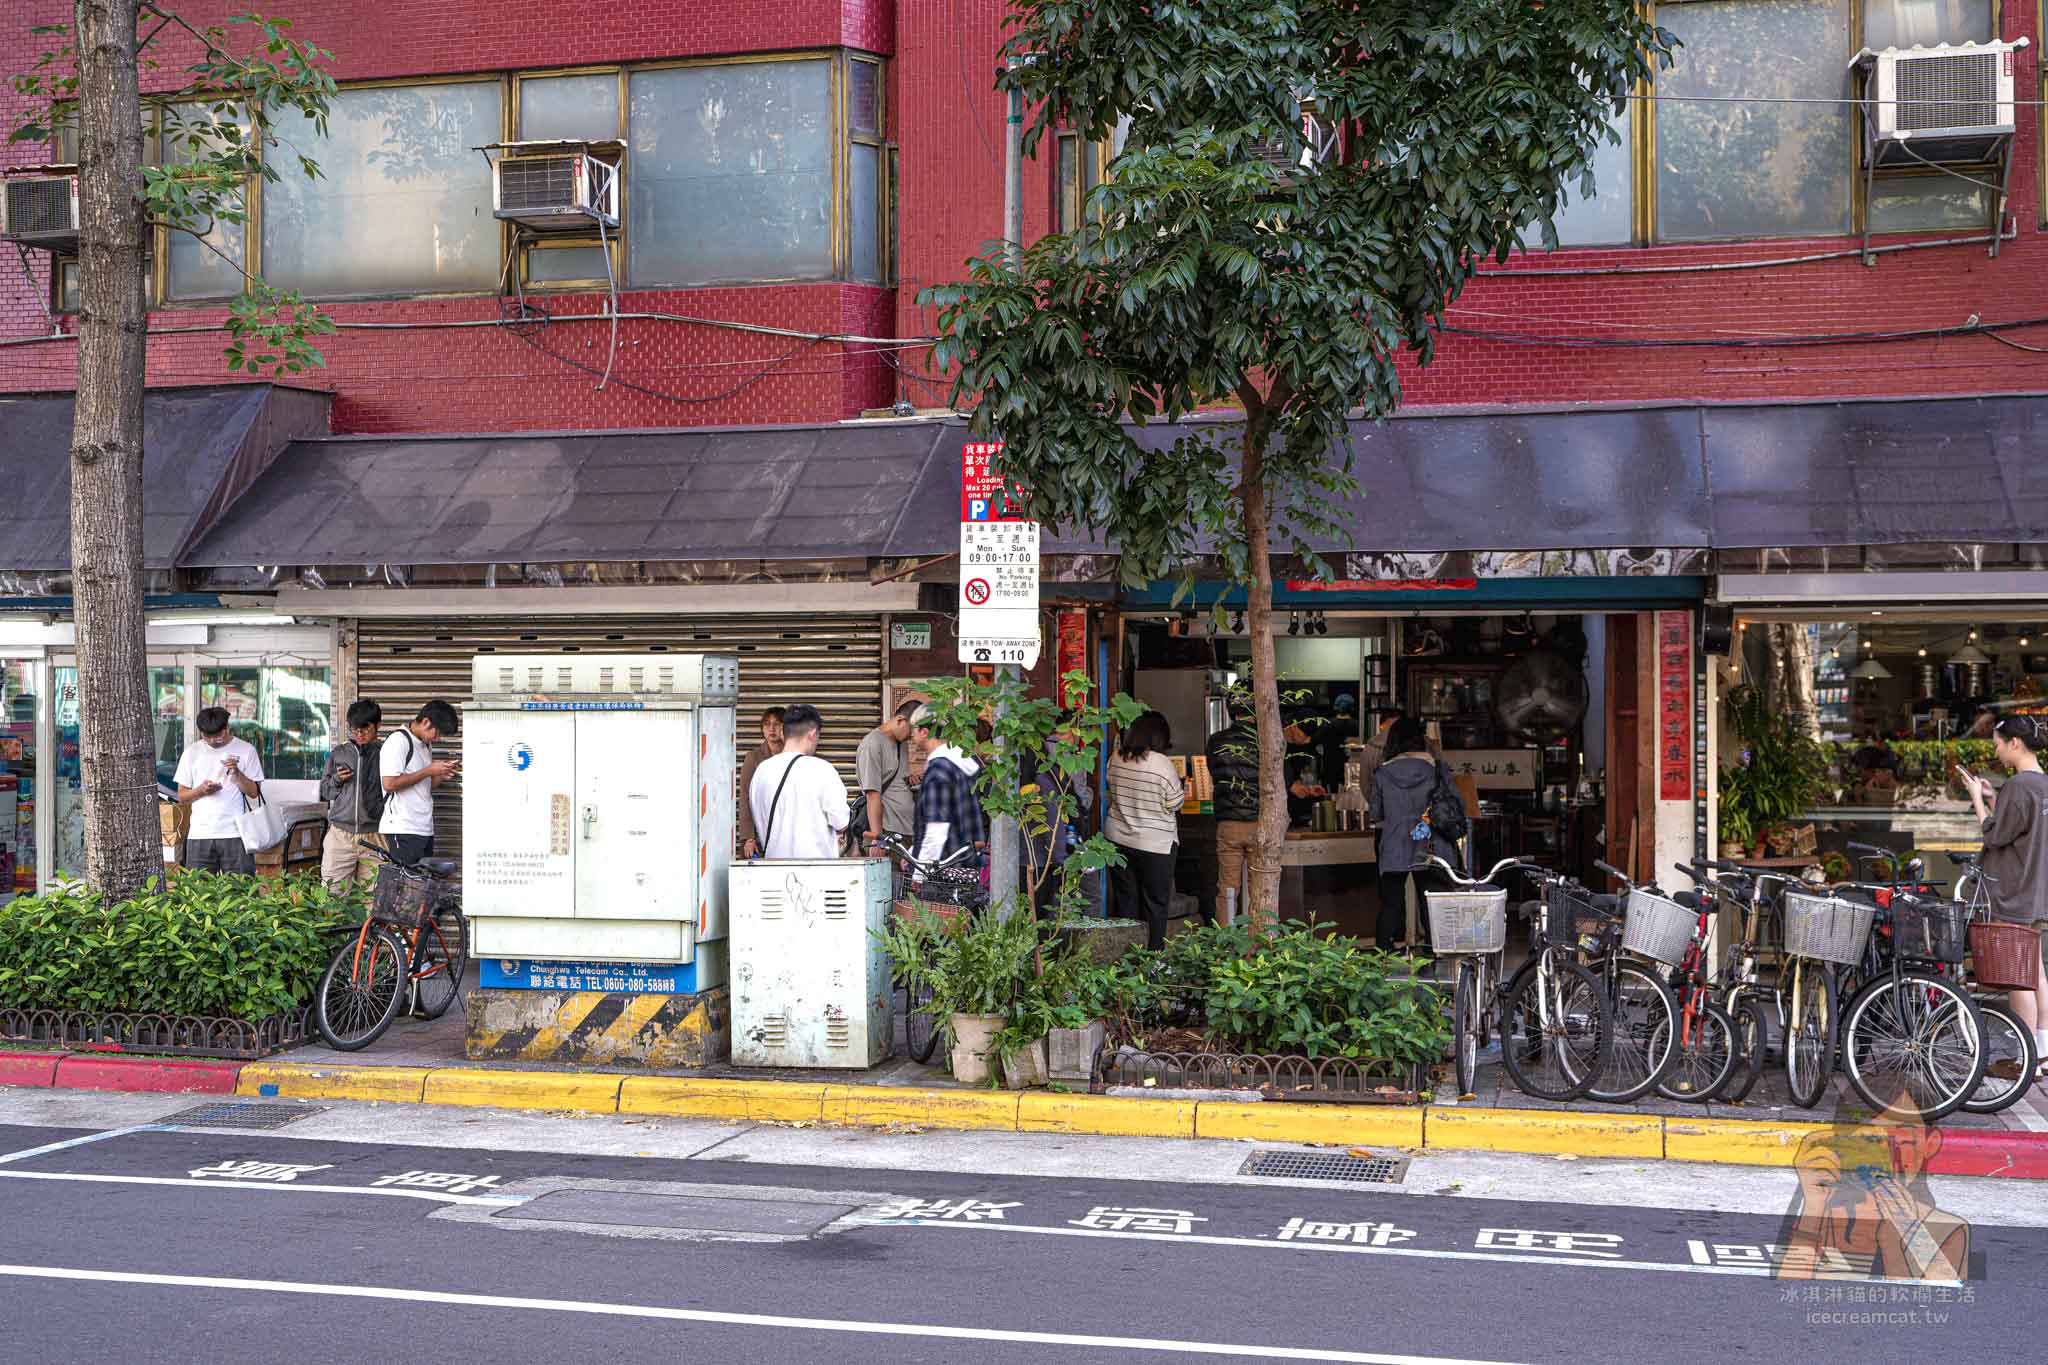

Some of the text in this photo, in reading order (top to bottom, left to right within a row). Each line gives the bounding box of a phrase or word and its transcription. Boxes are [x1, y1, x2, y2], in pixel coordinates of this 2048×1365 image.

[971, 500, 985, 520] P
[965, 534, 1035, 543] 週一至週日
[976, 544, 993, 552] Mon
[1011, 544, 1026, 552] Sun
[904, 634, 926, 646] 321
[1000, 649, 1025, 661] 110
[530, 964, 570, 975] Chunghwa
[575, 966, 609, 975] Telecom
[633, 968, 648, 976] Ltd.
[530, 974, 581, 989] 聯絡電話
